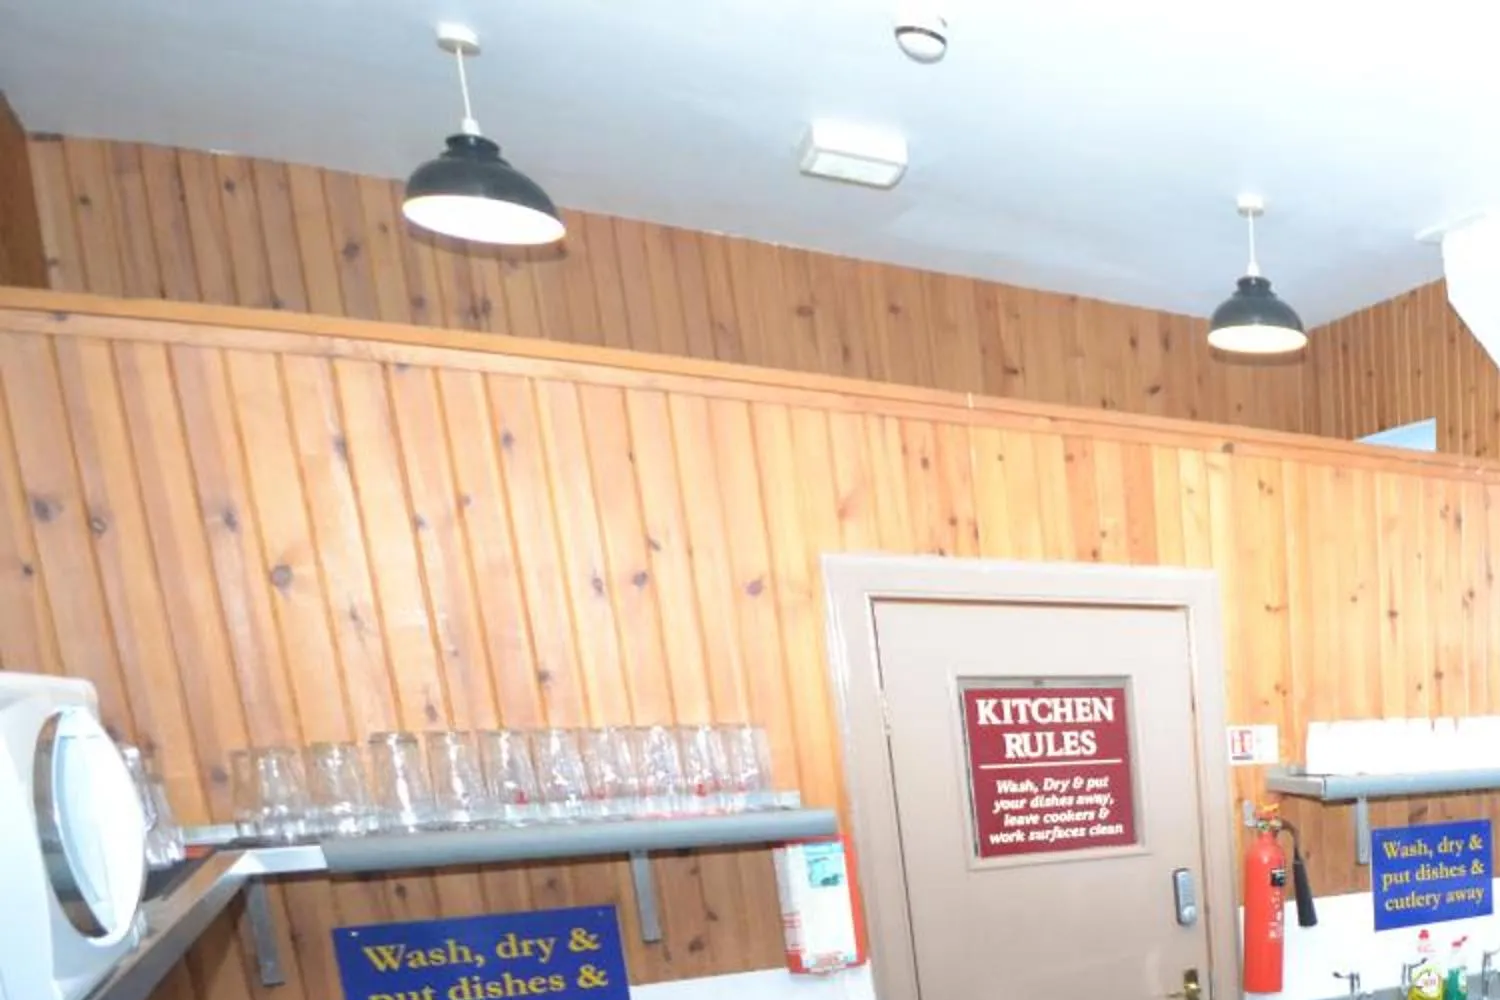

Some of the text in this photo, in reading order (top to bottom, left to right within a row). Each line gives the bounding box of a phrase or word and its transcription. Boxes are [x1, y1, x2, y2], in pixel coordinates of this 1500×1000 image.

[976, 697, 1114, 725] KITCHEN
[1003, 730, 1097, 759] RULES
[996, 776, 1109, 794] Wash, Dry & put
[993, 793, 1115, 813] your dishes away,
[1004, 808, 1110, 826] leave cookers &
[990, 823, 1124, 844] work surfaces clean
[1383, 834, 1482, 859] Wash, dry &
[1382, 858, 1484, 892] put dishes &
[1385, 887, 1484, 911] cutlery away
[364, 927, 599, 972] Wash, dry &
[577, 964, 608, 989] &
